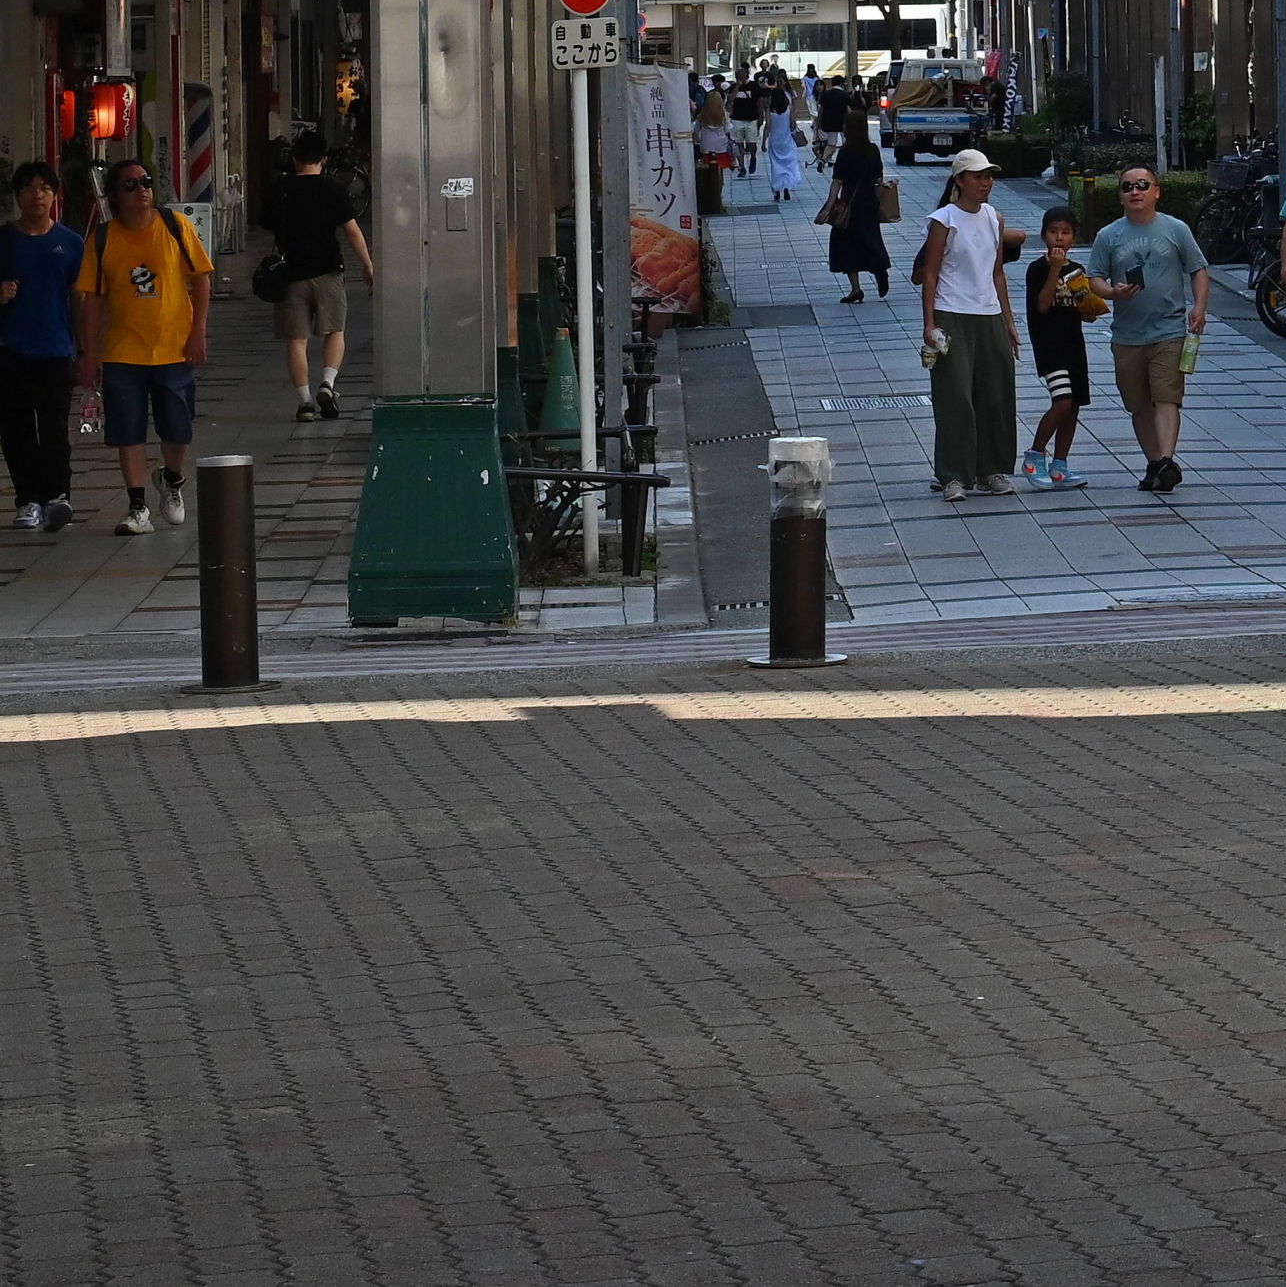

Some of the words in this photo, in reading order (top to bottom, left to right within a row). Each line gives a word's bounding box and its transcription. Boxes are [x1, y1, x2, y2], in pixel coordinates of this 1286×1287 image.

[555, 22, 617, 40] 自動車
[555, 41, 618, 66] ここから
[649, 86, 665, 119] 絶品
[1002, 59, 1019, 134] TAKOYAKI
[645, 123, 677, 218] 串カツ
